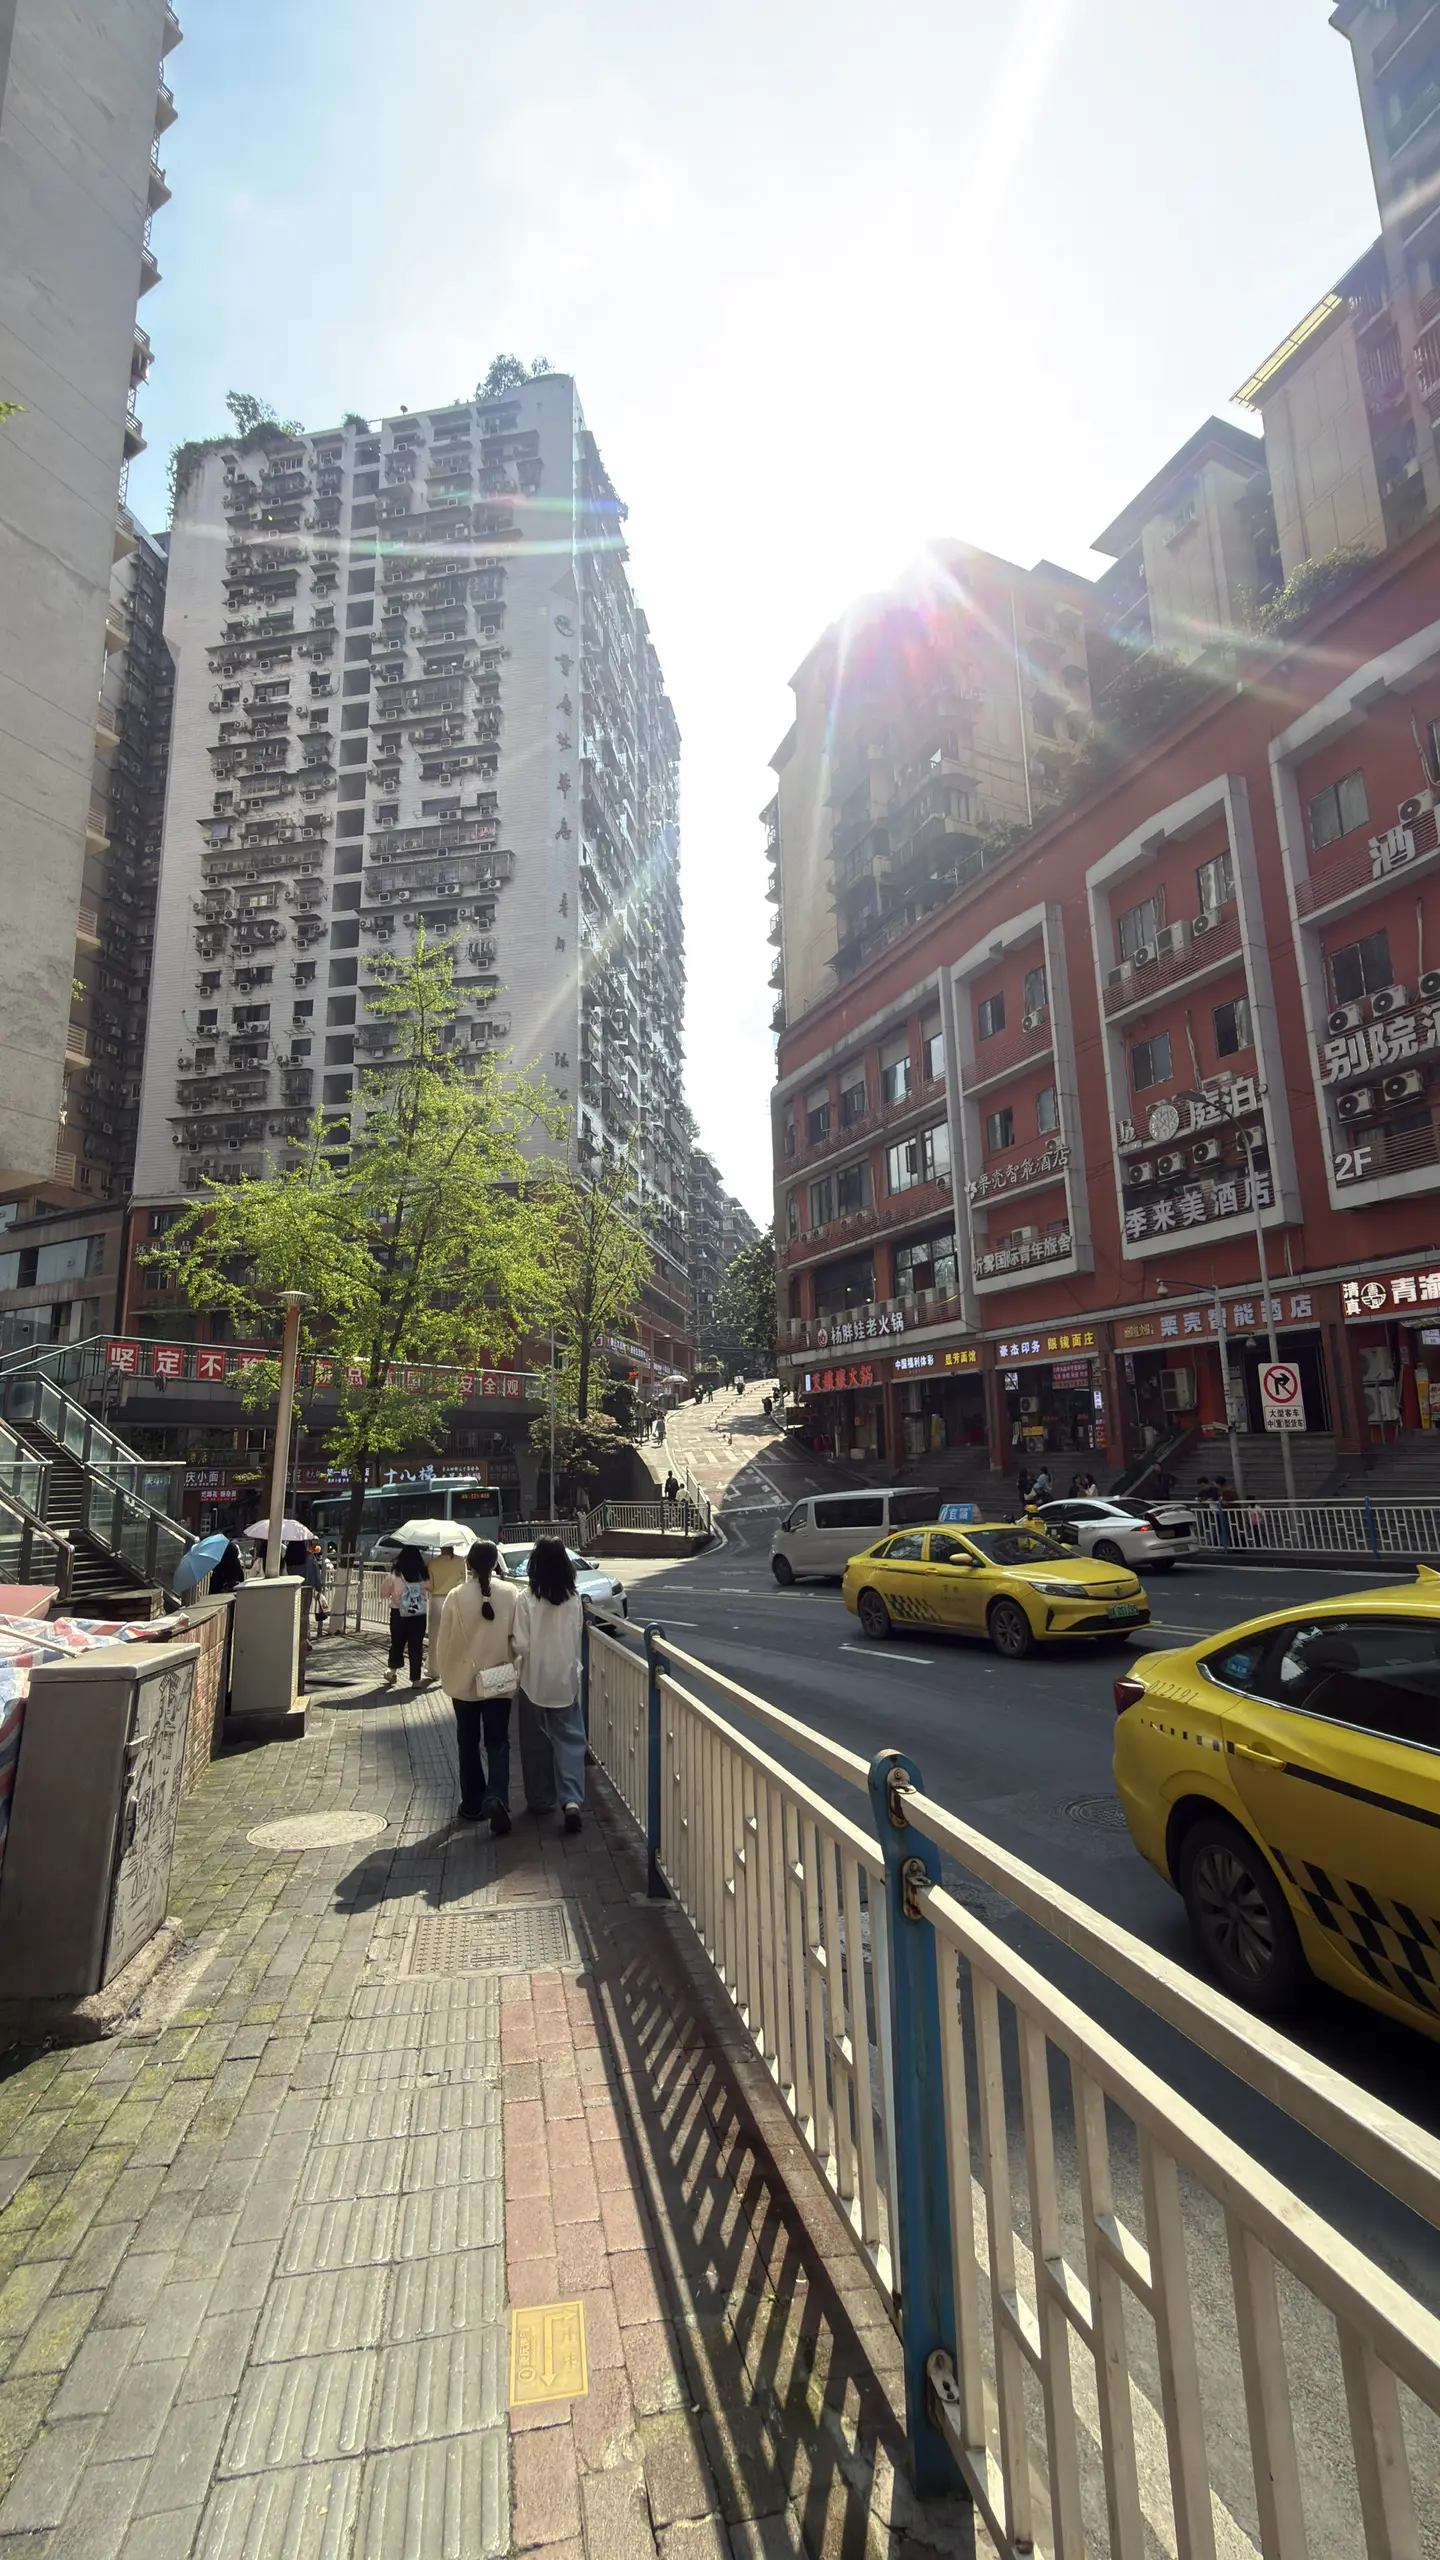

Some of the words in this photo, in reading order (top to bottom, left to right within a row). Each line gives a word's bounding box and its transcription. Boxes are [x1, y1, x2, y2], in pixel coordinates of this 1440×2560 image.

[1334, 1146, 1372, 1181] 2F
[1125, 1171, 1271, 1239] 季来美酒店
[1160, 1294, 1313, 1338] 栗壳智能酒店
[1343, 1281, 1361, 1316] 清真
[1269, 1409, 1300, 1418] 大型客车
[1147, 1679, 1199, 1705] 012191
